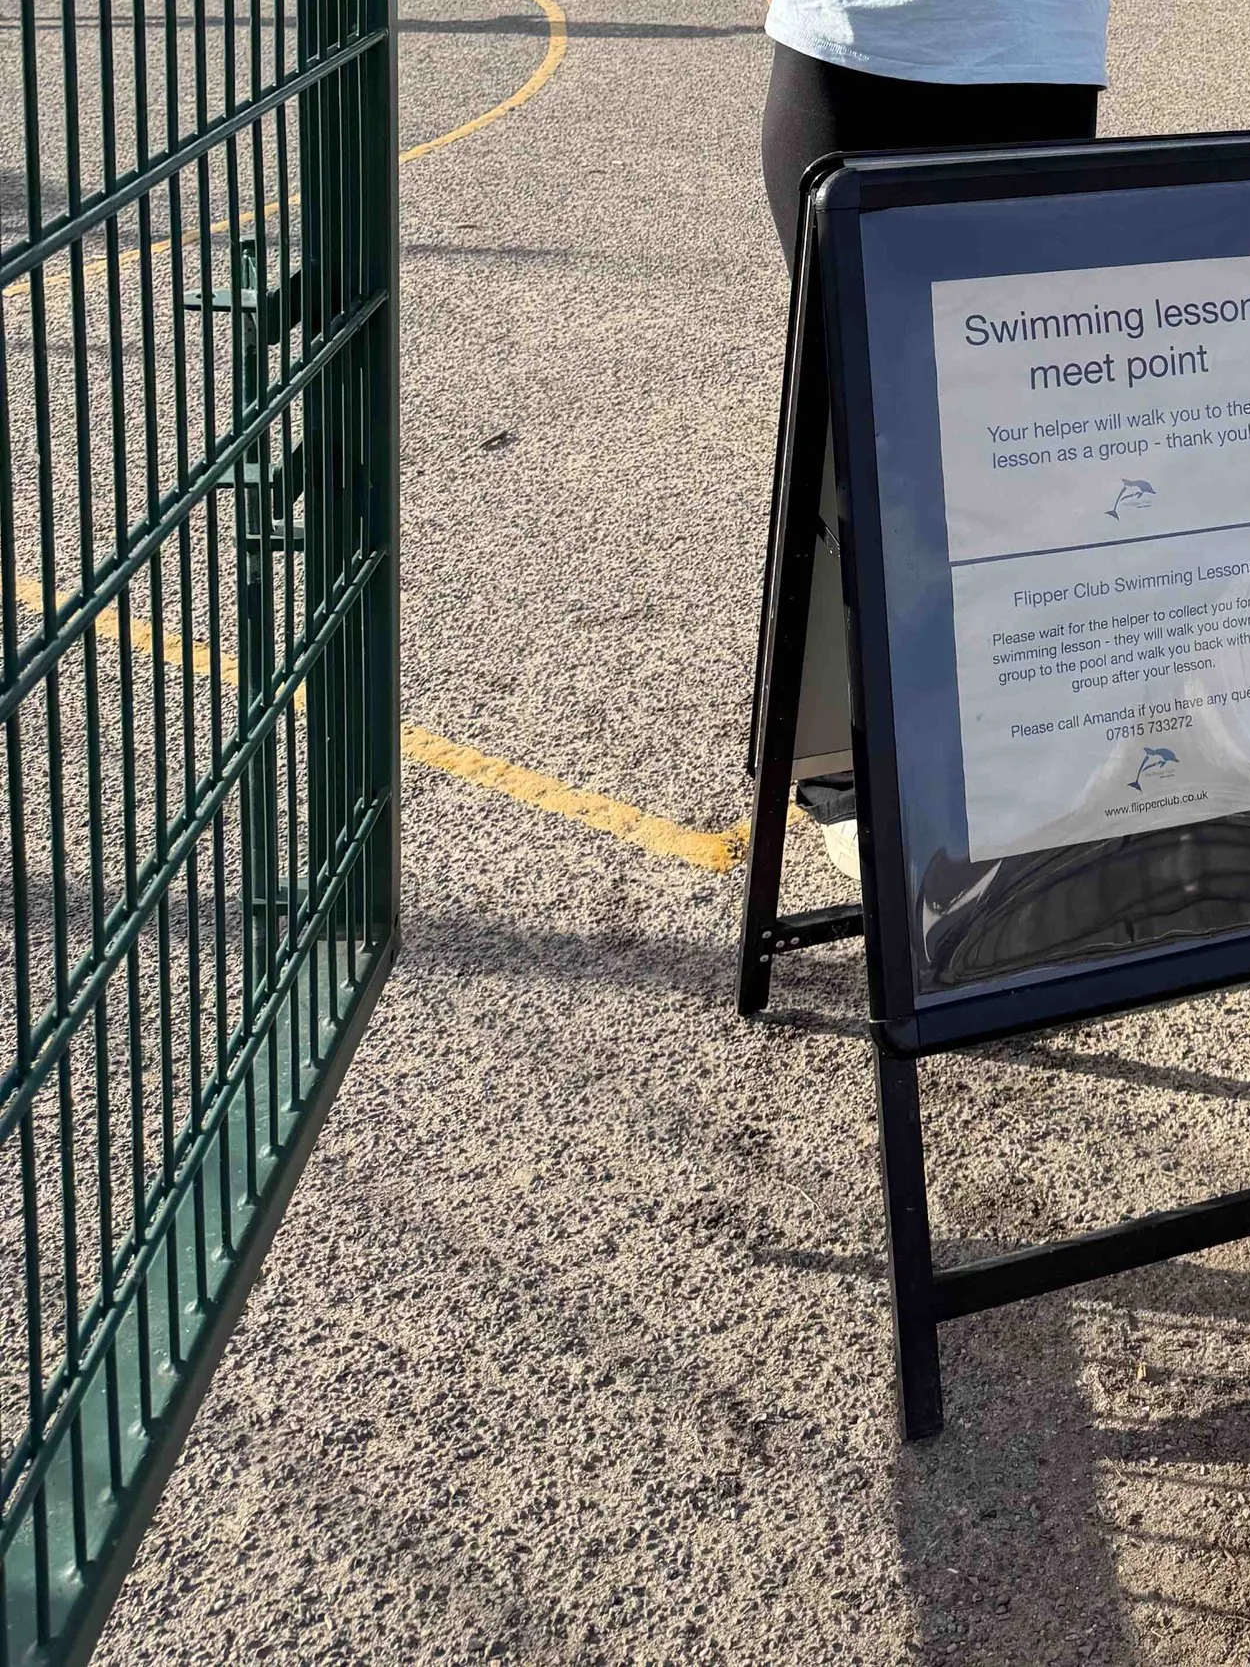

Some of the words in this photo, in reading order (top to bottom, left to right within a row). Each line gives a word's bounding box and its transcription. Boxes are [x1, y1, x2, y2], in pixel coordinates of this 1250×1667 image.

[965, 305, 1144, 346] Swimming
[1030, 353, 1115, 389] meet
[1128, 344, 1209, 387] point
[988, 424, 1028, 443] Your
[1034, 417, 1090, 443] helper
[1095, 412, 1121, 431] will
[1127, 408, 1166, 428] walk
[1170, 407, 1201, 428] you
[1205, 404, 1222, 419] to
[992, 447, 1051, 469] lesson
[1057, 444, 1078, 461] as
[1083, 442, 1093, 458] a
[1099, 438, 1149, 462] group
[1166, 428, 1211, 448] thank
[1014, 586, 1069, 608] Flipper
[1074, 580, 1110, 598] Club
[1115, 568, 1192, 593] Swimming
[993, 630, 1035, 646] Please
[1039, 624, 1065, 639] wait
[1068, 620, 1085, 635] for
[1089, 617, 1108, 631] the
[1112, 610, 1149, 630] helper
[1153, 609, 1165, 622] to
[1169, 603, 1208, 620] collect
[1211, 601, 1232, 618] you
[993, 644, 1057, 666] swimming
[1061, 635, 1101, 653] lesson
[1114, 632, 1140, 649] they
[1144, 626, 1162, 641] will
[1166, 622, 1194, 639] walk
[1197, 621, 1219, 638] you
[998, 665, 1036, 686] group
[1039, 662, 1052, 676] to
[1056, 658, 1076, 674] the
[1080, 653, 1107, 674] pool
[1111, 649, 1134, 666] and
[1137, 645, 1165, 662] walk
[1168, 644, 1191, 661] you
[1194, 636, 1223, 653] back
[1227, 632, 1250, 648] with
[1072, 674, 1108, 693] group
[1112, 668, 1140, 685] after
[1143, 665, 1171, 684] your
[1174, 657, 1215, 672] lesson.
[1011, 722, 1054, 739] Please
[1057, 716, 1080, 731] call
[1083, 707, 1135, 726] Amanda
[1138, 704, 1146, 717] if
[1149, 703, 1171, 722] you
[1174, 695, 1203, 712] have
[1206, 691, 1228, 709] any
[1106, 722, 1144, 742] 07815
[1148, 715, 1193, 735] 733272
[1104, 790, 1208, 818] www.flipperclub.co.uk
